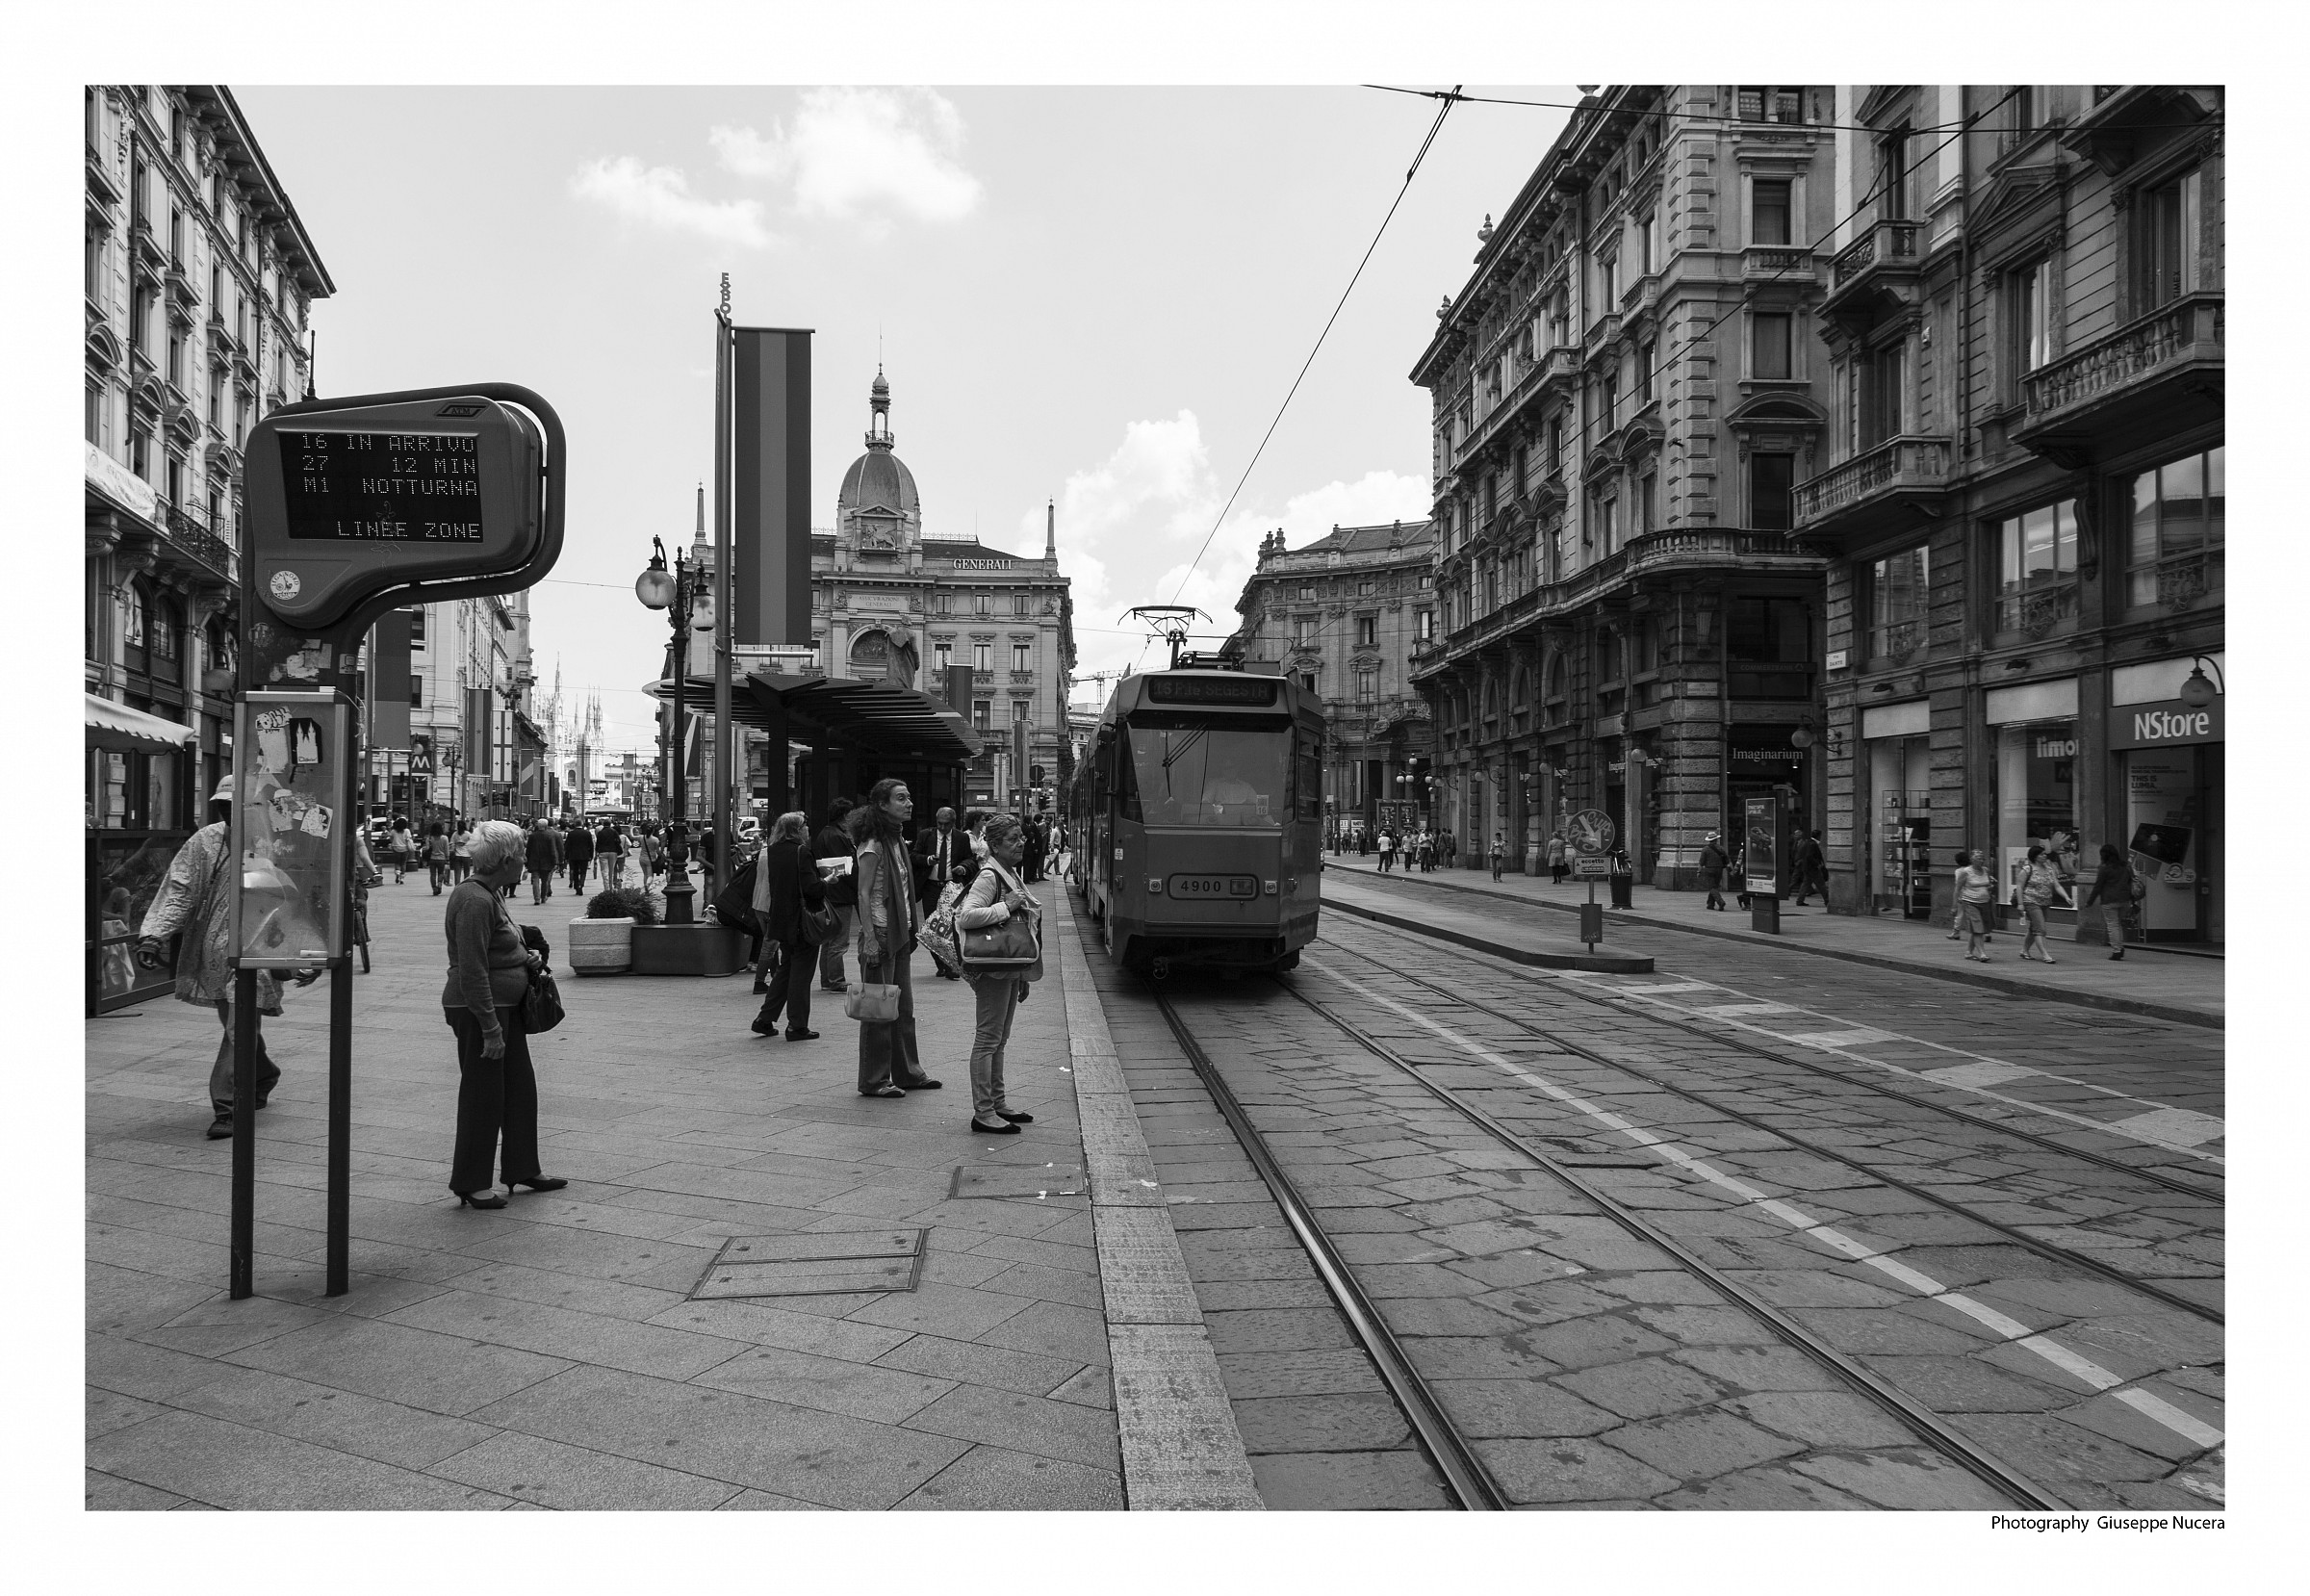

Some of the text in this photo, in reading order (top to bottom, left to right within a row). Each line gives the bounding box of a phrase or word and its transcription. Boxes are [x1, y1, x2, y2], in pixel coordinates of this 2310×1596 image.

[720, 272, 732, 314] EXPO
[302, 433, 475, 451] 16 IN ARRIVO
[302, 455, 475, 474] 27 12 MIN
[304, 476, 477, 496] M1 NOTTURNA
[337, 521, 480, 538] LINEE ZONE
[953, 559, 1012, 570] GENERALI
[2135, 711, 2210, 740] NStore
[1732, 747, 1804, 761] Imaginarium
[1180, 880, 1221, 892] 4900
